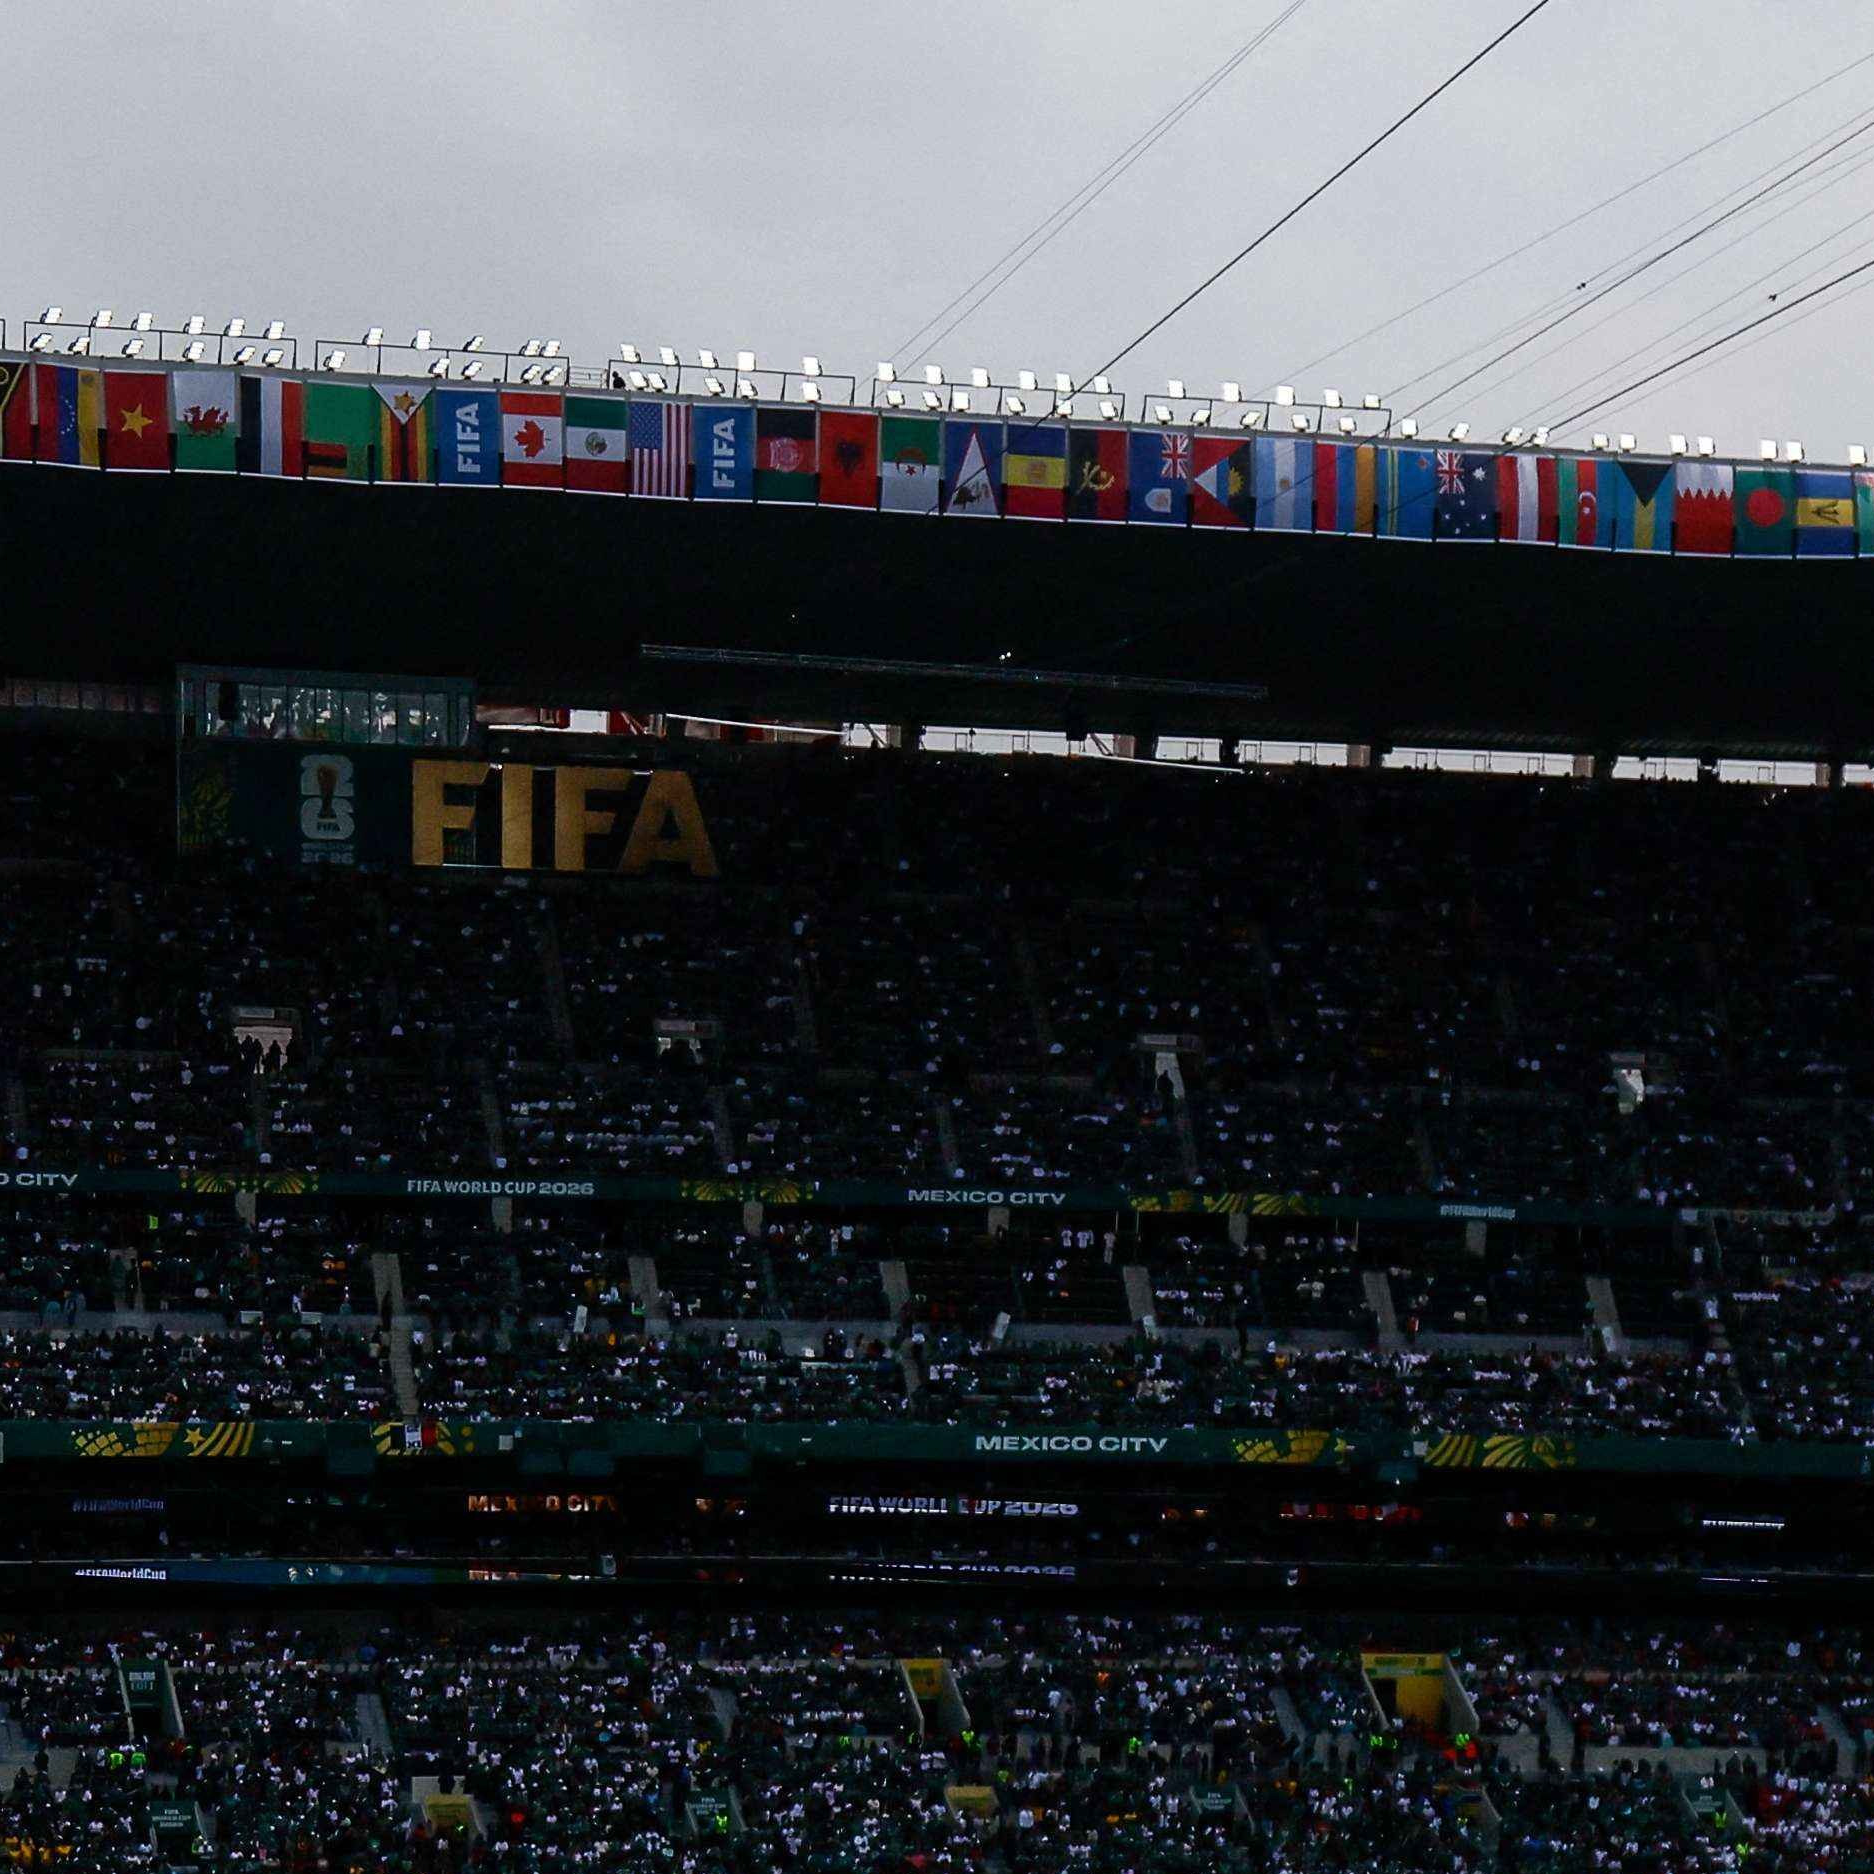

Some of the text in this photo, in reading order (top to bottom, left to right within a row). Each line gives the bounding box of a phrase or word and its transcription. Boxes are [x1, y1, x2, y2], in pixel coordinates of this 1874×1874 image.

[458, 401, 479, 473] FIFA
[714, 417, 736, 488] FIFA
[411, 757, 722, 877] FIFA
[16, 1173, 78, 1187] CITY
[407, 1180, 595, 1196] FIFA WORLD CUP 2026
[908, 1189, 1066, 1205] MEXICO CITY
[975, 1435, 1168, 1452] MEXICO CITY
[828, 1496, 876, 1514] FIFA
